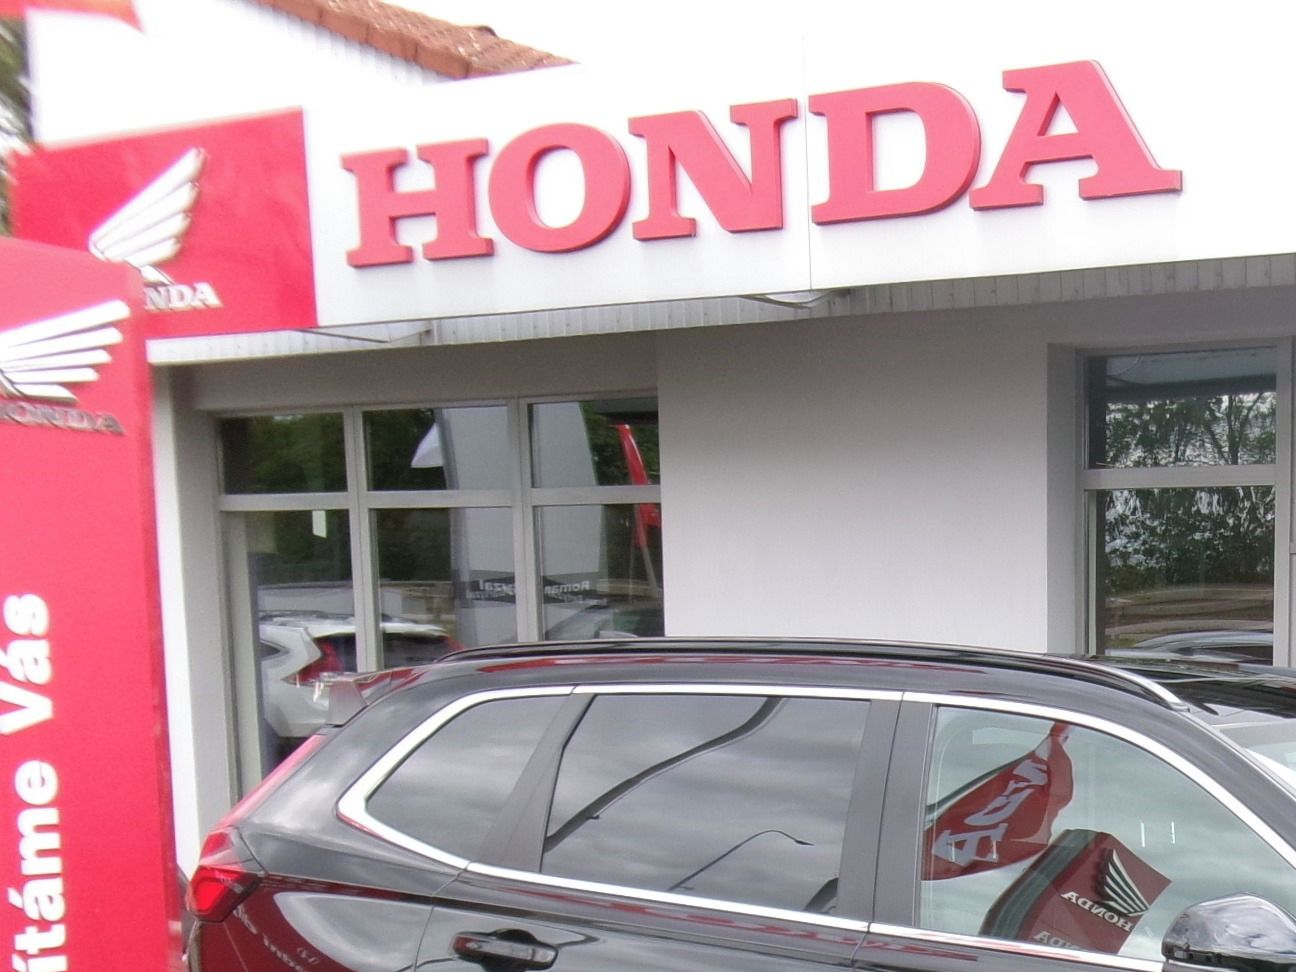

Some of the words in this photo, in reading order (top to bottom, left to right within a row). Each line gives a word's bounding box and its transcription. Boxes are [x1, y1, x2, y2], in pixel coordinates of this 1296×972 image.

[341, 59, 1183, 269] HONDA
[144, 282, 224, 312] NDA
[0, 402, 126, 436] ONDA
[0, 593, 54, 736] Vás
